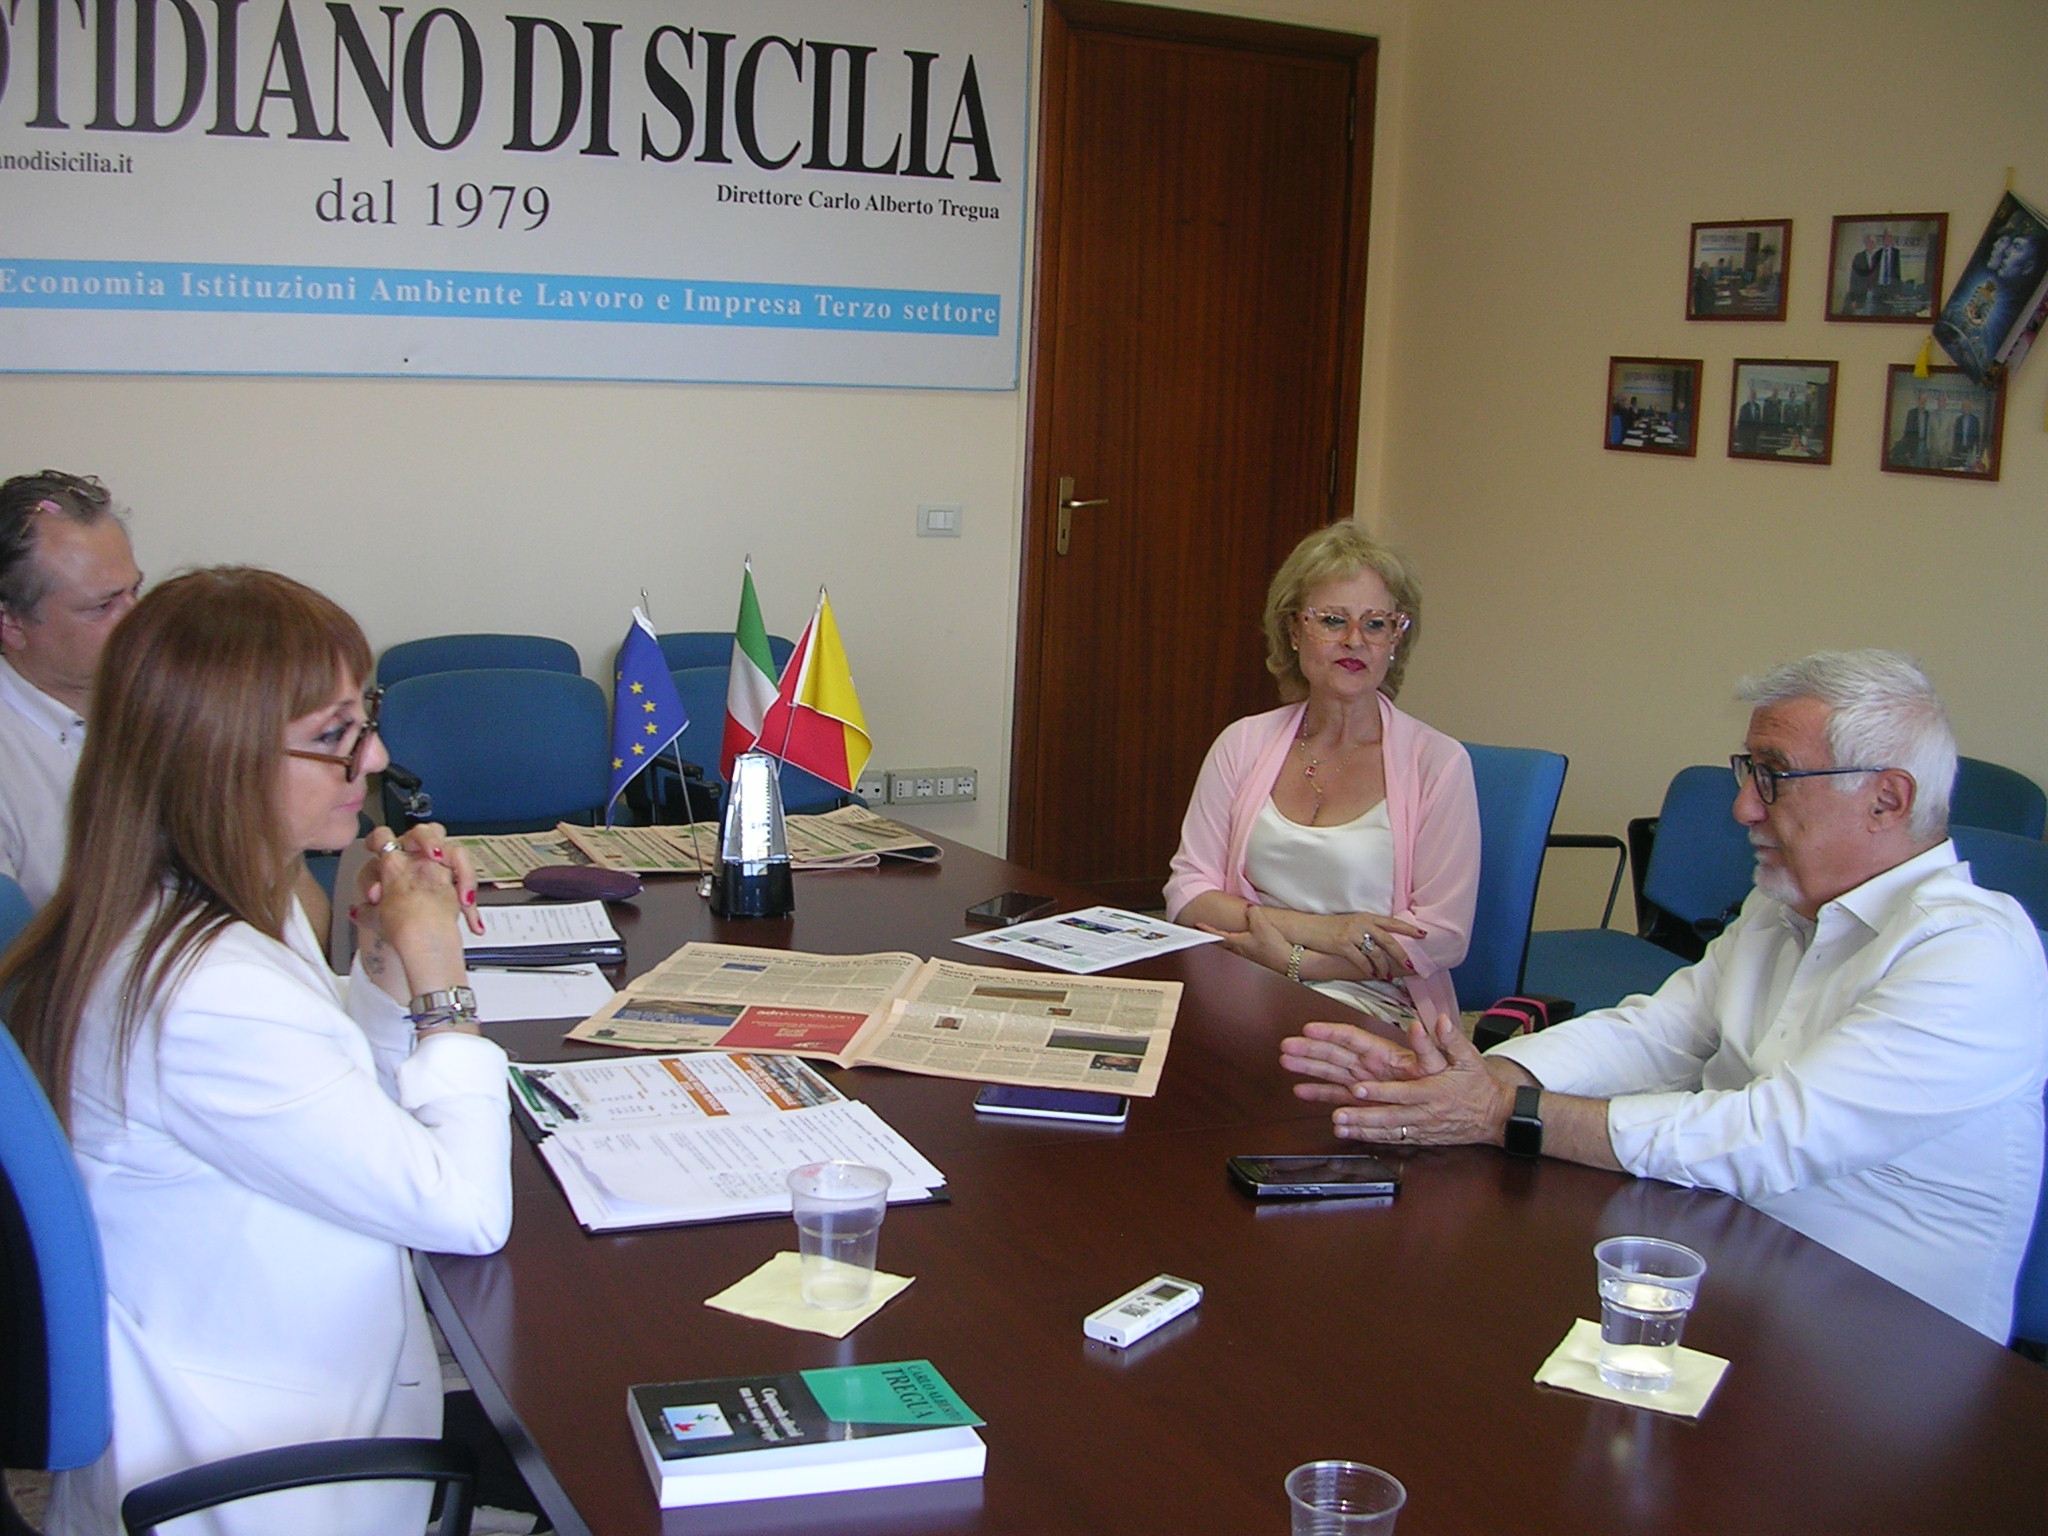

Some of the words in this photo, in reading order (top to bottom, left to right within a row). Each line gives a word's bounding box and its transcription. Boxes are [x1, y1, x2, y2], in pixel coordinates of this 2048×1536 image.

[0, 0, 484, 151] TIDIANO
[502, 15, 623, 157] DI
[640, 24, 1002, 183] SICILIA
[315, 178, 398, 225] dal
[426, 183, 550, 231] 1979
[716, 184, 802, 207] Direttore
[808, 190, 860, 211] Carlo
[865, 195, 934, 216] Alberto
[938, 199, 1000, 222] Tregua
[0, 269, 165, 296] Economia
[180, 272, 356, 302] Istituzioni
[370, 278, 522, 306] Ambiente
[536, 283, 644, 311] Lavoro
[656, 293, 670, 311] e
[684, 288, 802, 318] Impresa
[815, 295, 891, 319] Terzo
[903, 303, 997, 325] settore
[881, 1368, 936, 1419] TREGUA
